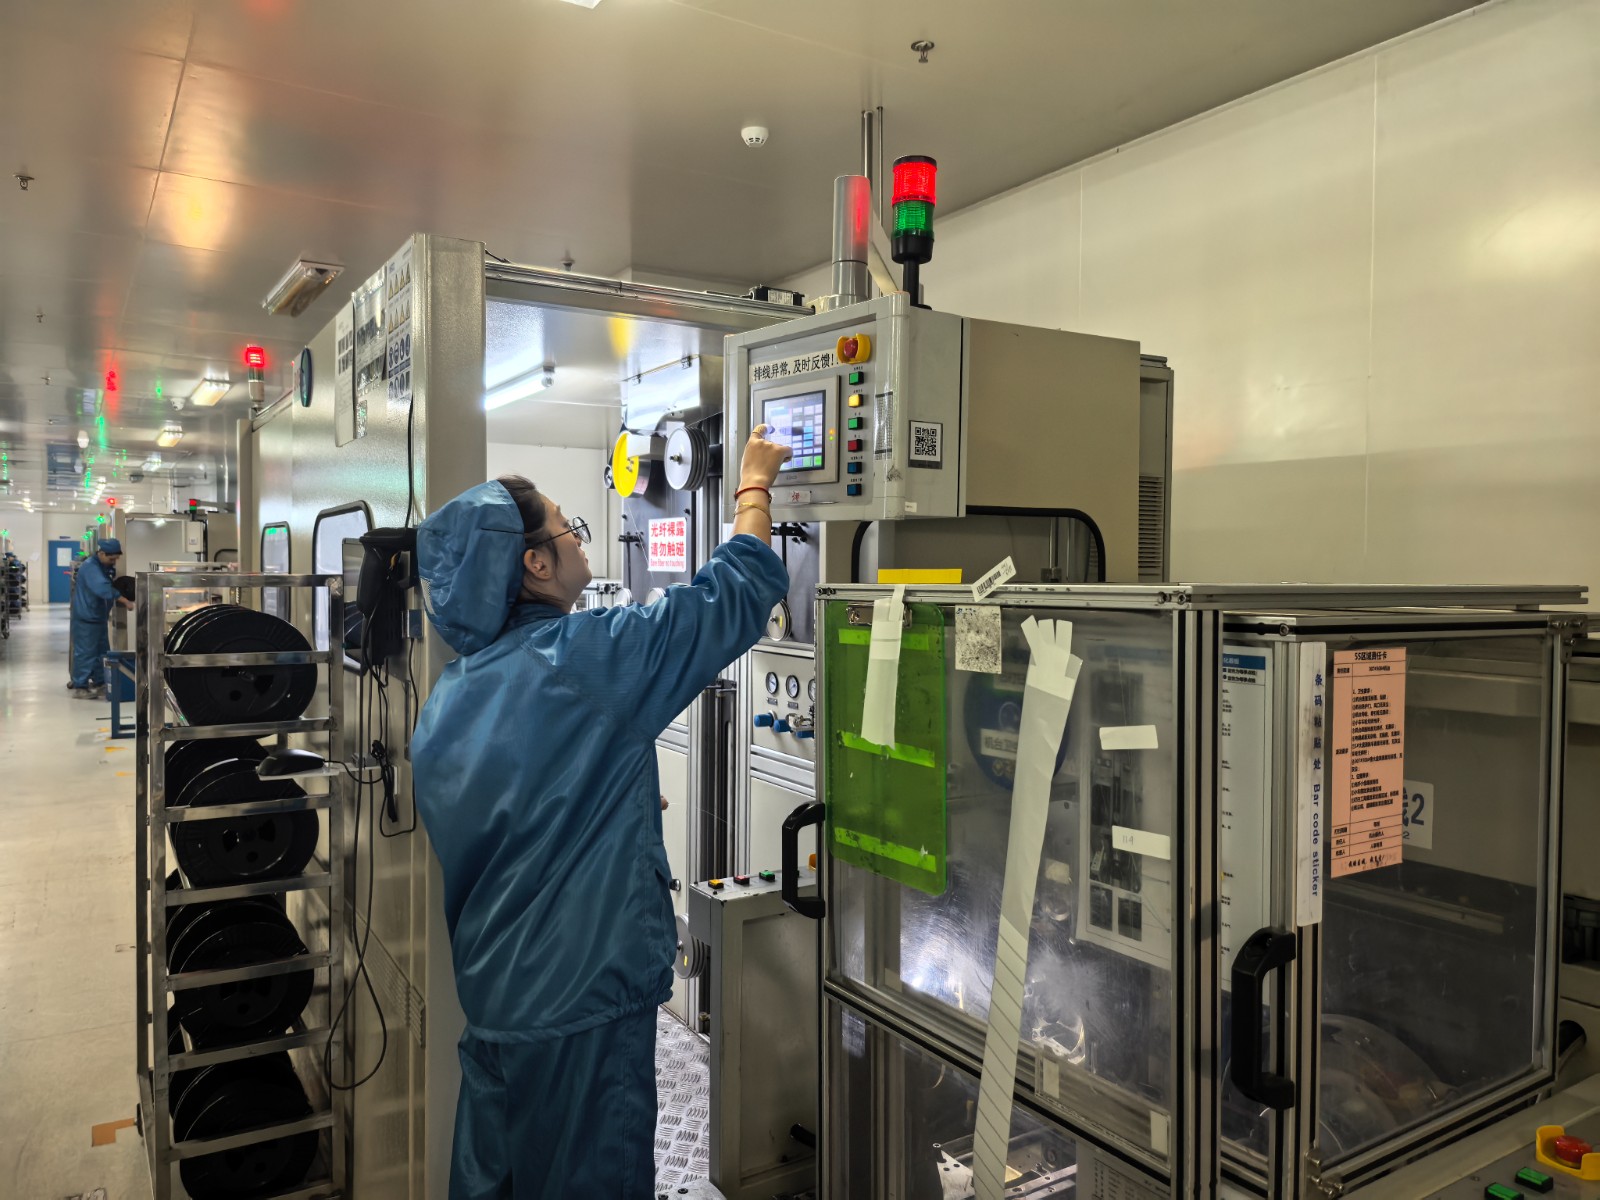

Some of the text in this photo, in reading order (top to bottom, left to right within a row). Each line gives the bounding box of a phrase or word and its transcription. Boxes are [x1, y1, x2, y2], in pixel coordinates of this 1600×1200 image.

[753, 353, 839, 382] 排线异常,及时反馈!
[650, 521, 685, 537] 光纤裸露
[650, 541, 685, 557] 请勿触碰
[1313, 673, 1323, 770] 条码粘贴处
[1312, 784, 1321, 897] Bar code sticker
